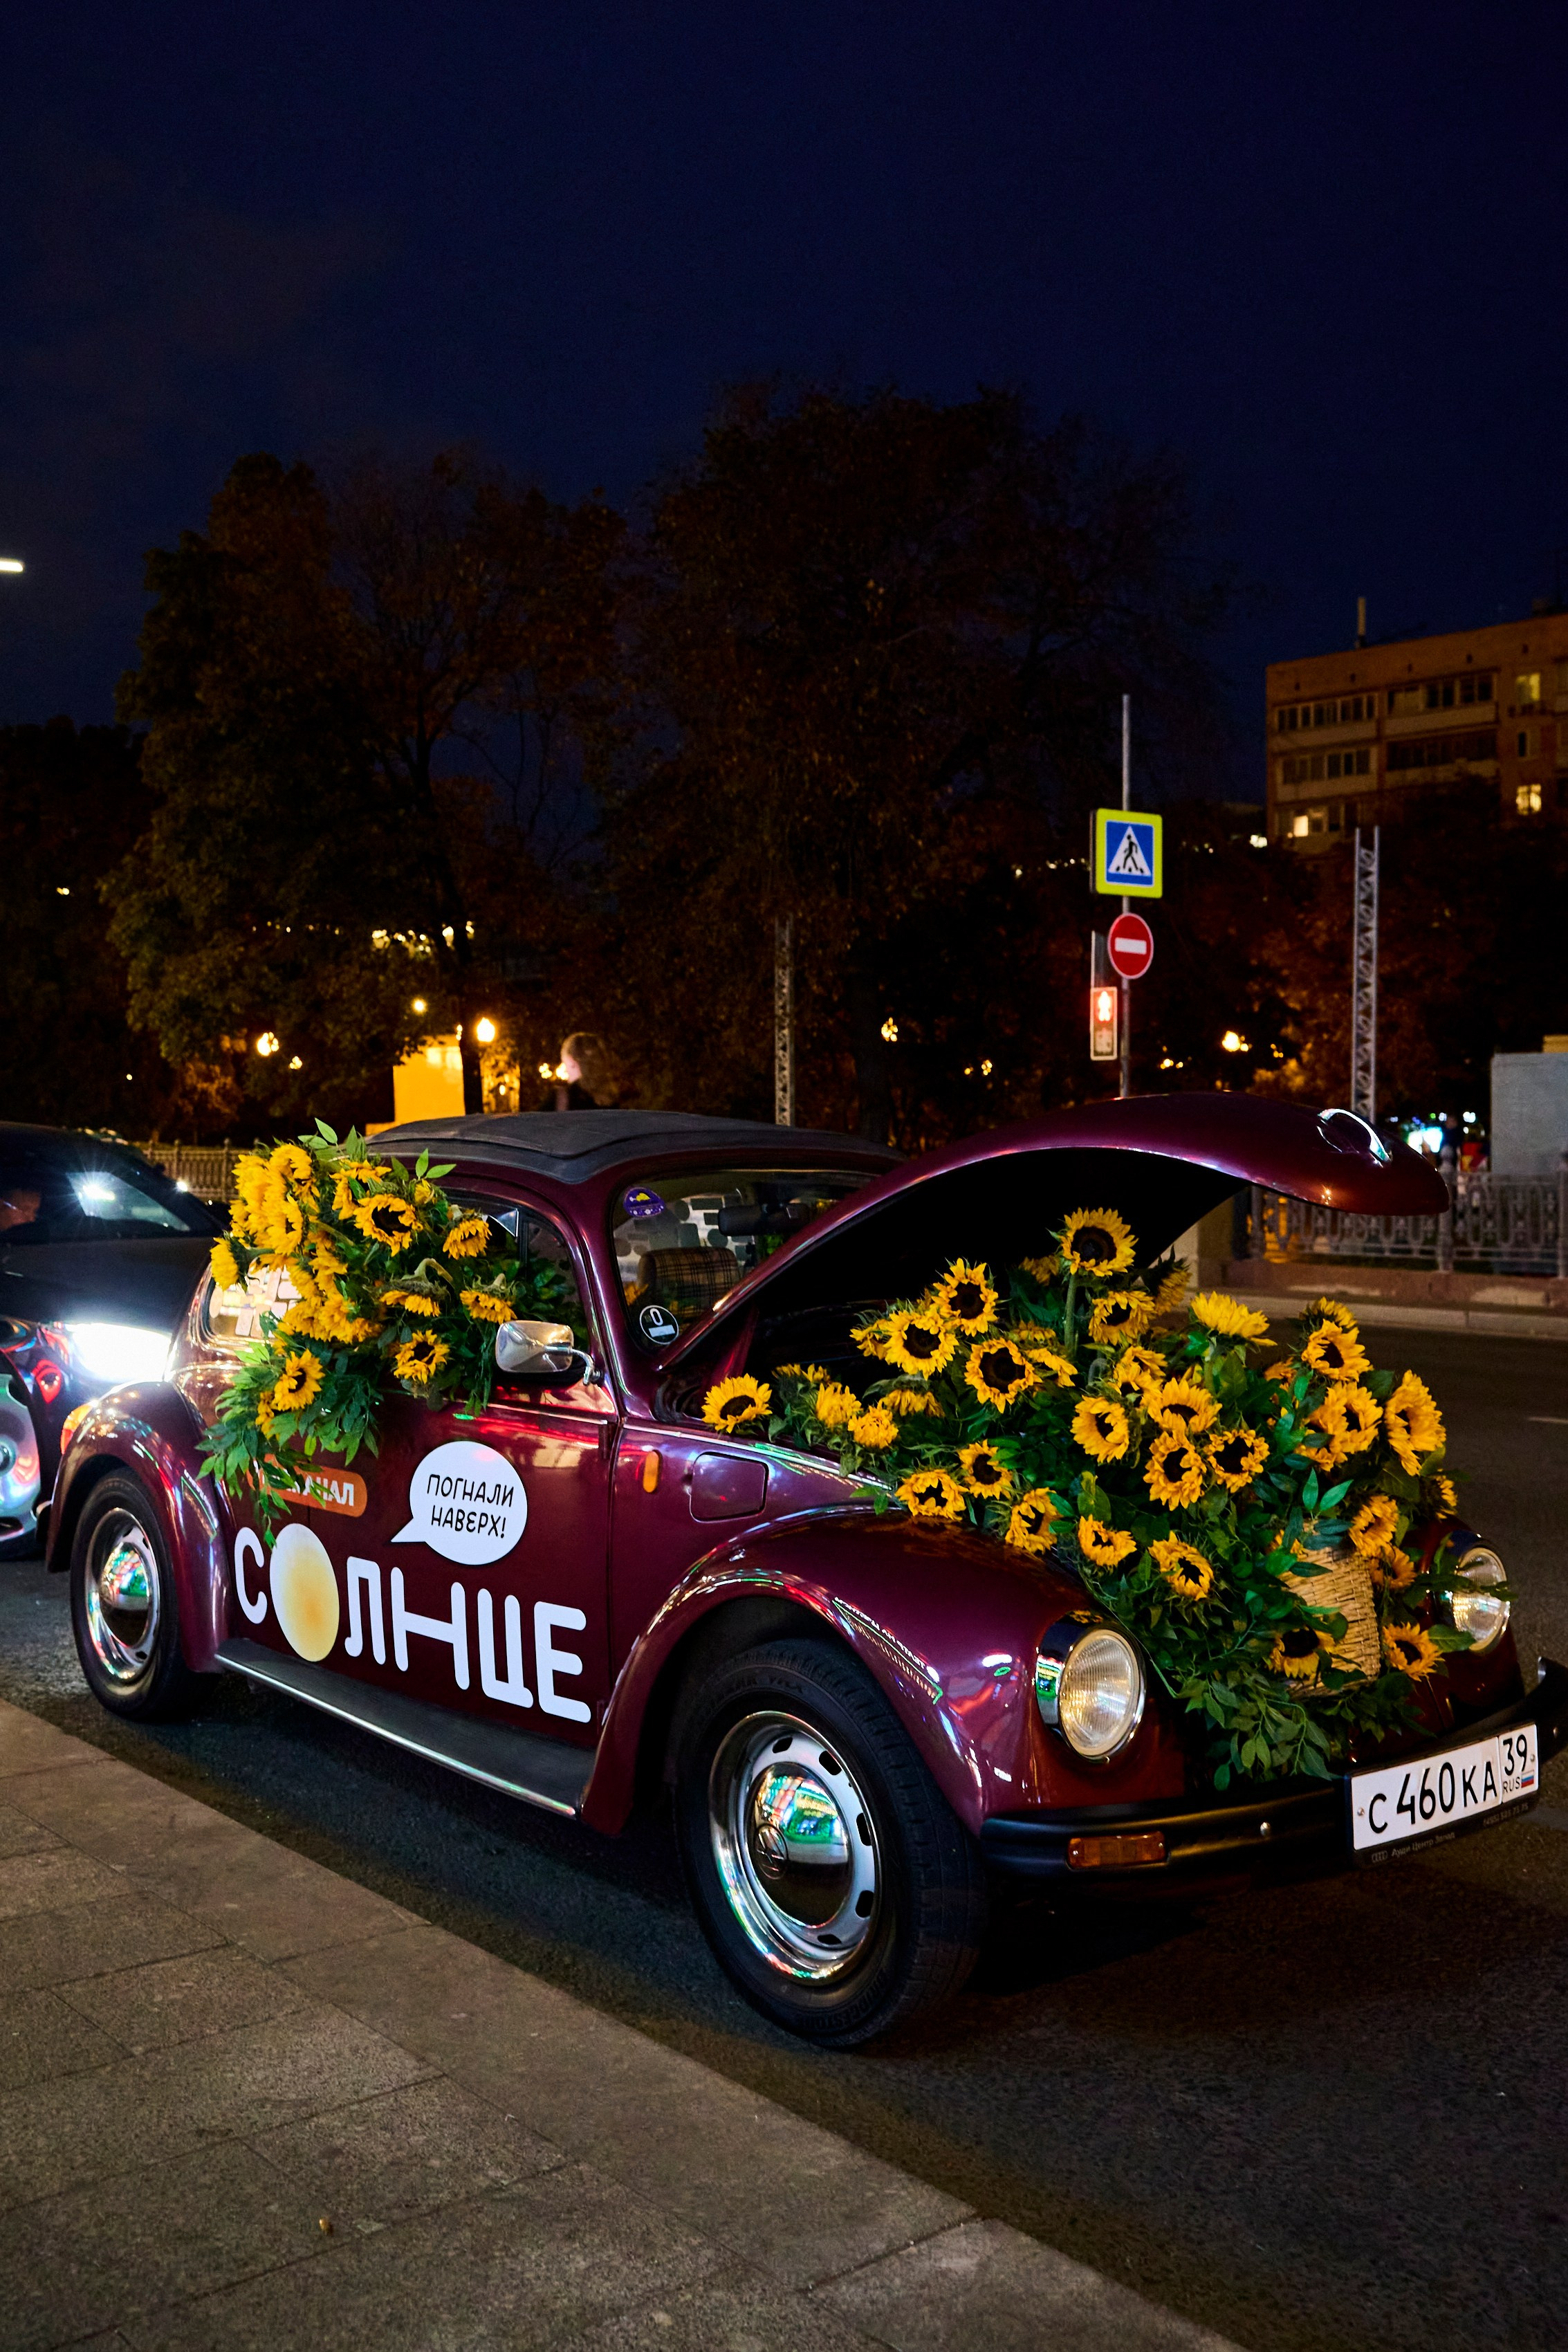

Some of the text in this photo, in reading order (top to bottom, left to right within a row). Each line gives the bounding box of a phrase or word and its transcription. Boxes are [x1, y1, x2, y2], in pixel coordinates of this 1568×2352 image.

[427, 1474, 514, 1508] ПОГНАЛИ
[431, 1505, 506, 1538] НАВЕРХ!
[1503, 1734, 1528, 1776] 39
[1503, 1777, 1520, 1794] RUS
